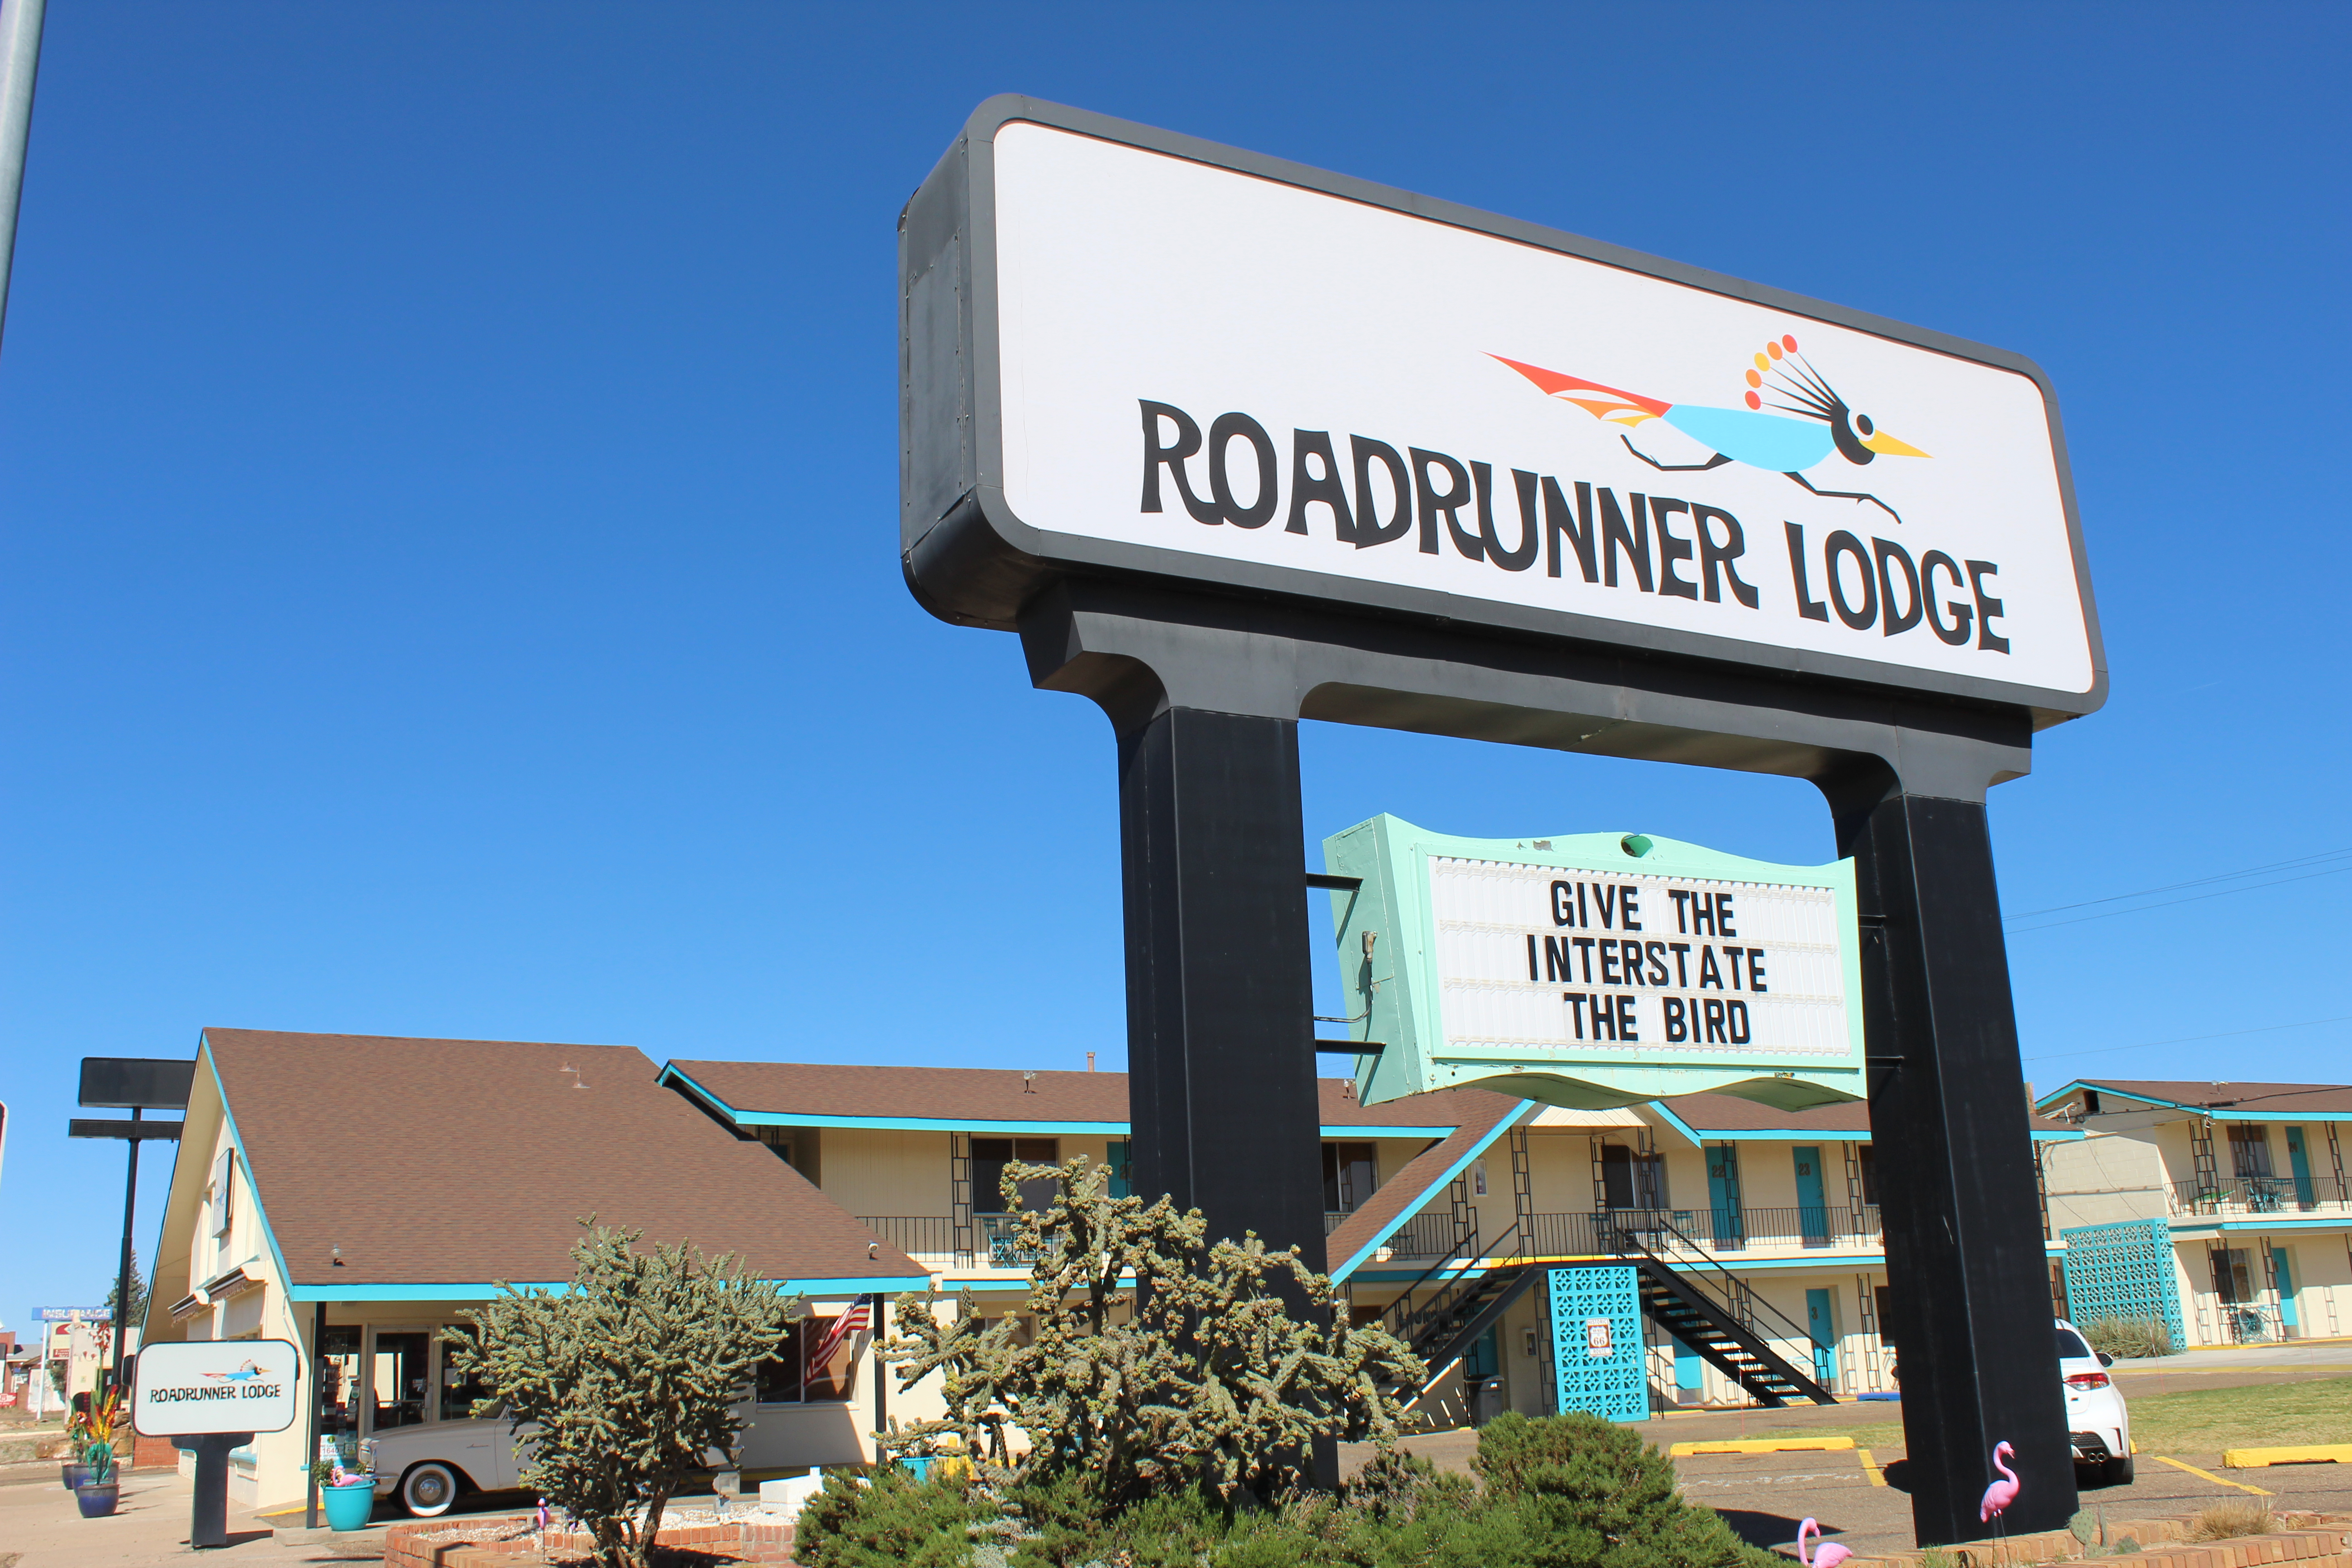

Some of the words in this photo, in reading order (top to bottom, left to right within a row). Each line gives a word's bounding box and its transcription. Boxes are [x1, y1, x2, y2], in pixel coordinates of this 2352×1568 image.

[1138, 399, 1759, 610] ROADRUNNER
[1784, 521, 2010, 655] LODGE
[1551, 880, 1642, 931] GIVE
[1668, 889, 1737, 937] THE
[1527, 935, 1768, 992] INTERSTATE
[1563, 992, 1639, 1041] THE
[1663, 997, 1750, 1044] BIRD
[1712, 1165, 1725, 1178] 22
[1798, 1163, 1811, 1176] 23
[1812, 1306, 1818, 1320] 3
[1593, 1336, 1605, 1346] 66
[150, 1386, 237, 1403] ROADRUNNER
[242, 1384, 281, 1399] LODGE
